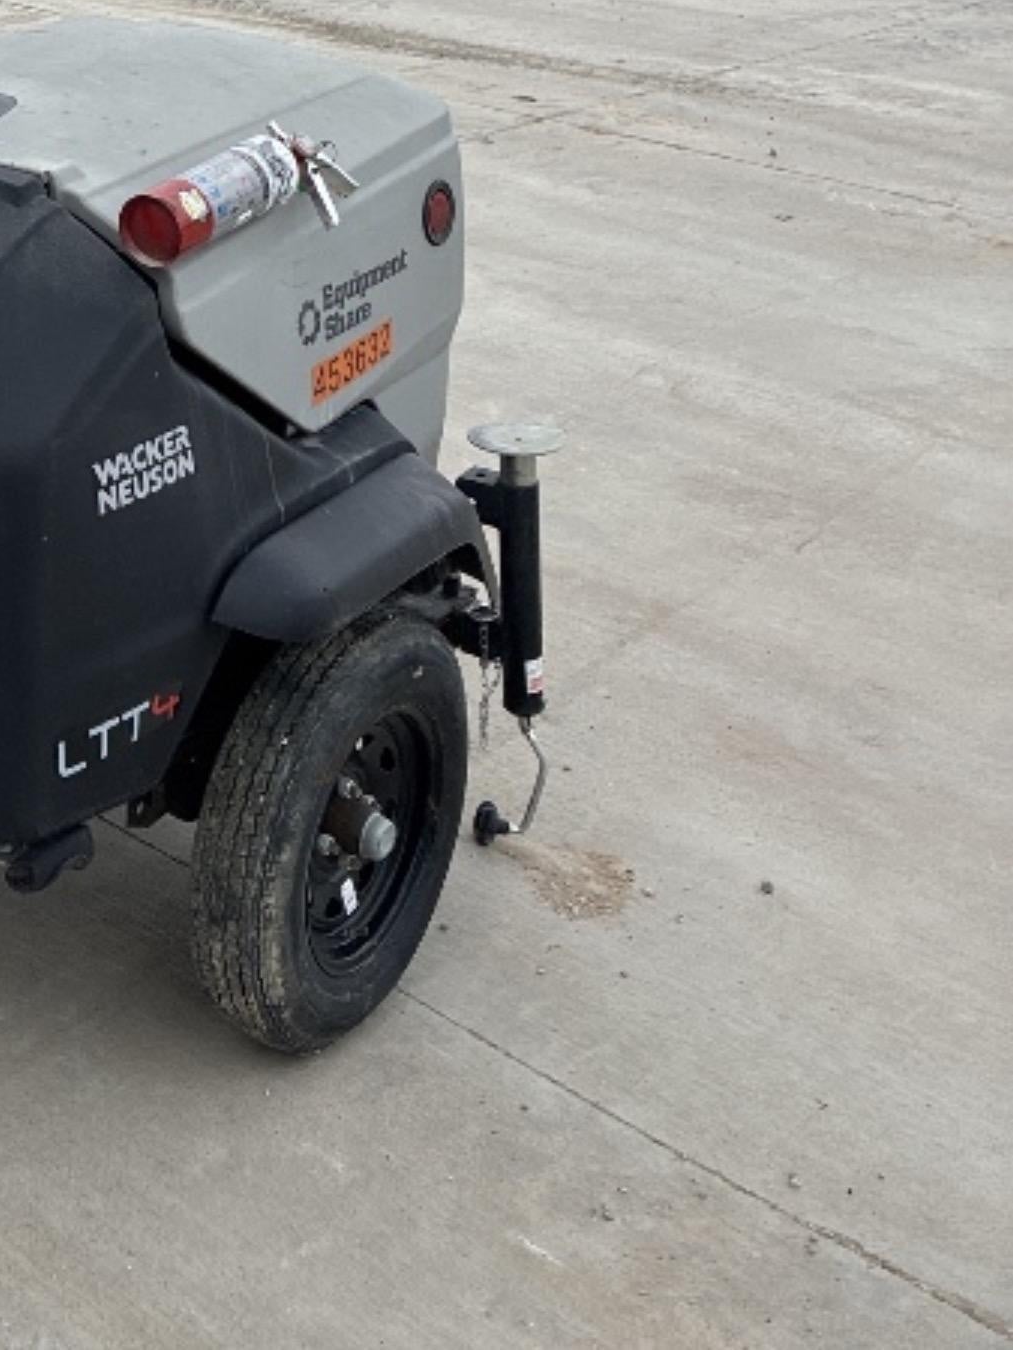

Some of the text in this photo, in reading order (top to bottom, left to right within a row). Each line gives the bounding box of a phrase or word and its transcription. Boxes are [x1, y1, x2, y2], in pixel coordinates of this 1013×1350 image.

[322, 248, 408, 312] Equipment
[324, 302, 372, 342] Share
[313, 323, 392, 397] 453632
[91, 425, 192, 486] WACKER
[97, 449, 196, 516] NEUSON
